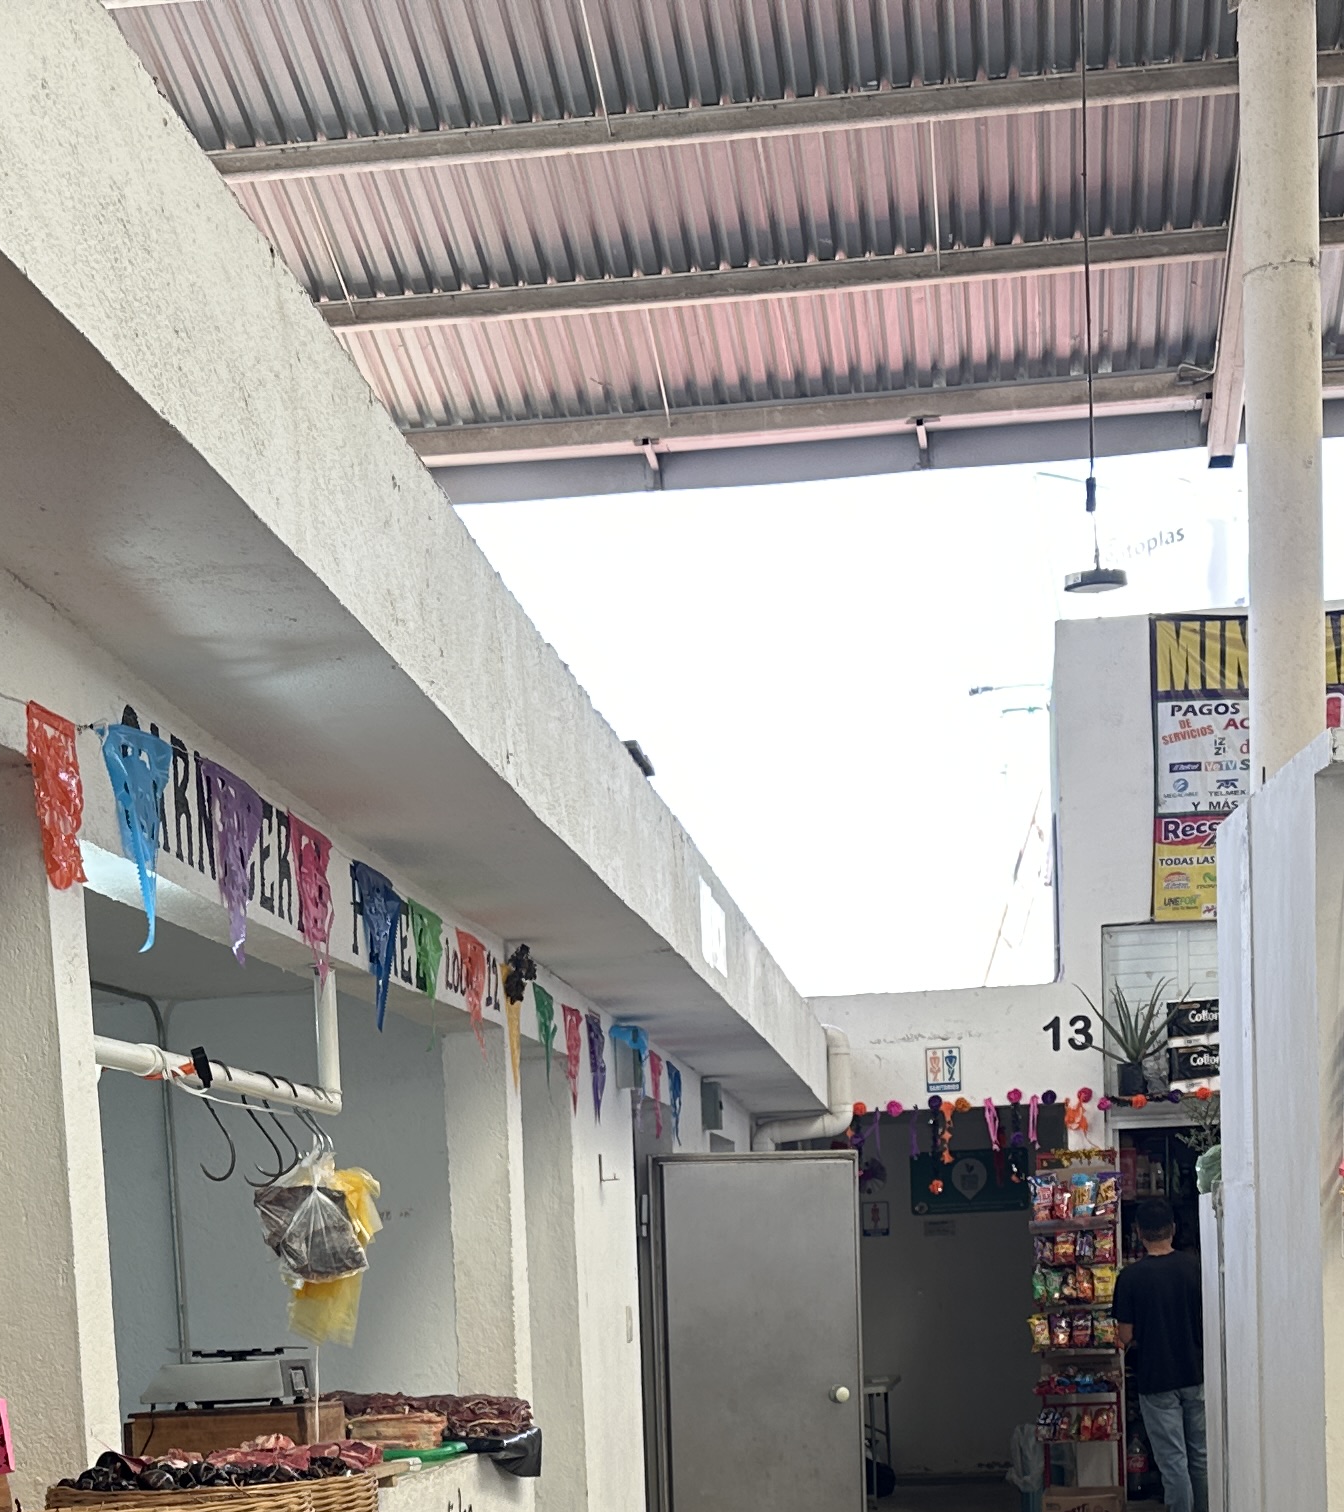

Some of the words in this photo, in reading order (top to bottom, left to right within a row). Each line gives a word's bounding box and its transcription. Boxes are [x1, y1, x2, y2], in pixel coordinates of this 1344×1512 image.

[1156, 619, 1249, 691] MIN
[1170, 703, 1240, 717] PAGOS
[1178, 718, 1193, 730] DE
[1161, 724, 1215, 746] SERVICIOS
[1191, 801, 1201, 811] Y
[1159, 857, 1194, 867] TODAS
[1197, 855, 1215, 865] LAS
[1042, 1014, 1094, 1051] 13
